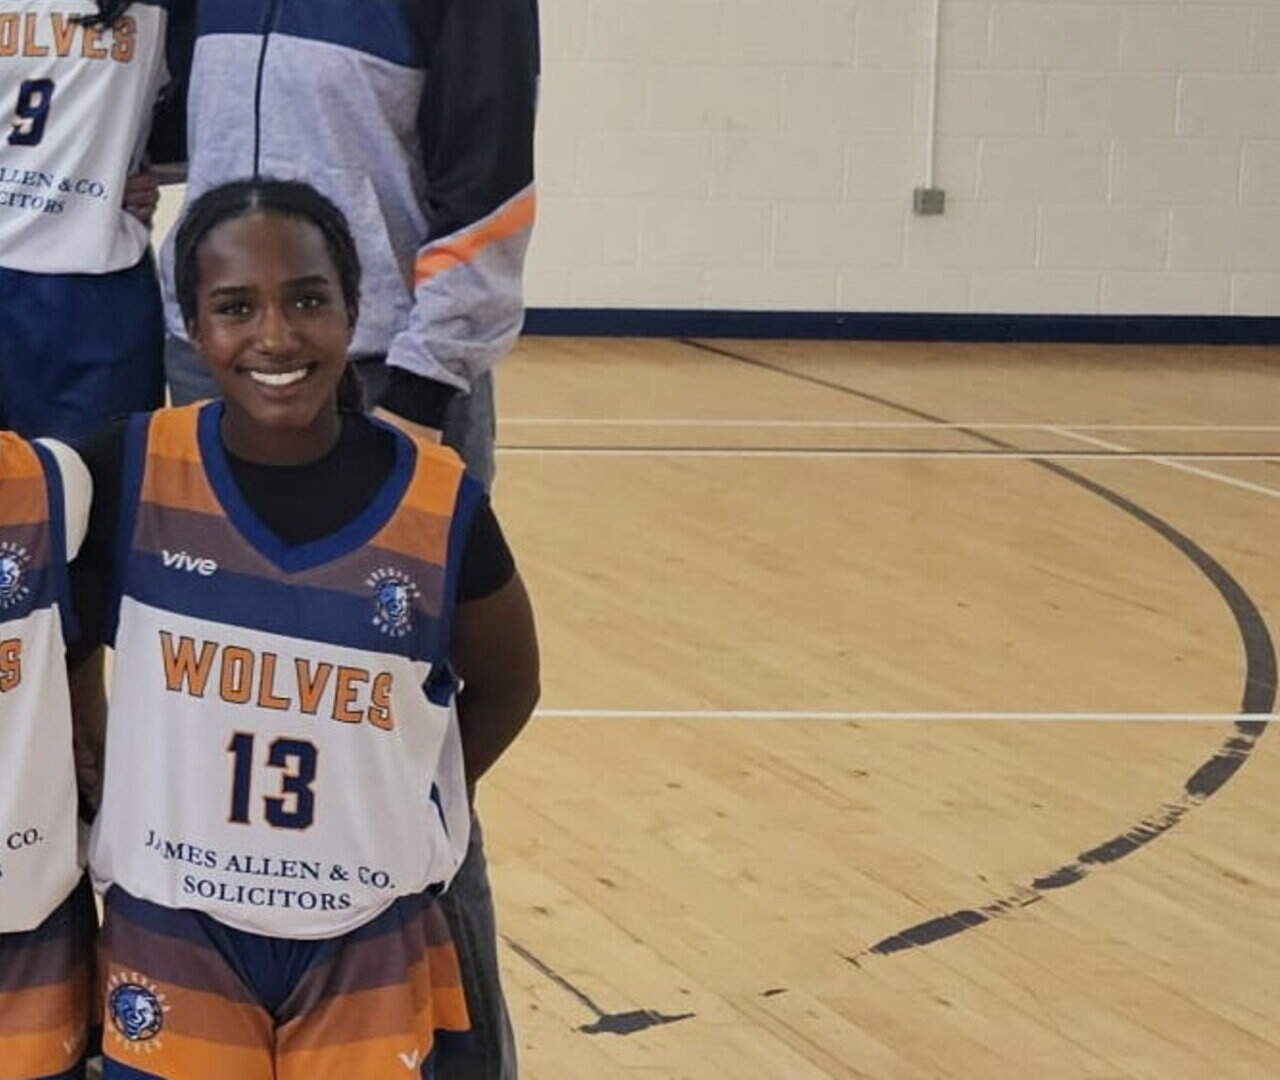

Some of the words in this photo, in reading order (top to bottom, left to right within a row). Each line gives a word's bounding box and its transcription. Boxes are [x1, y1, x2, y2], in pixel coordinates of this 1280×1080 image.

[7, 78, 56, 146] 9
[58, 178, 71, 192] &
[74, 178, 108, 200] CO.
[161, 548, 219, 576] vive
[158, 630, 395, 731] WOLVES
[227, 732, 319, 832] 13
[225, 855, 321, 881] ALLEN
[329, 864, 350, 882] &
[358, 866, 395, 890] CO.
[183, 875, 351, 910] SOLICITORS
